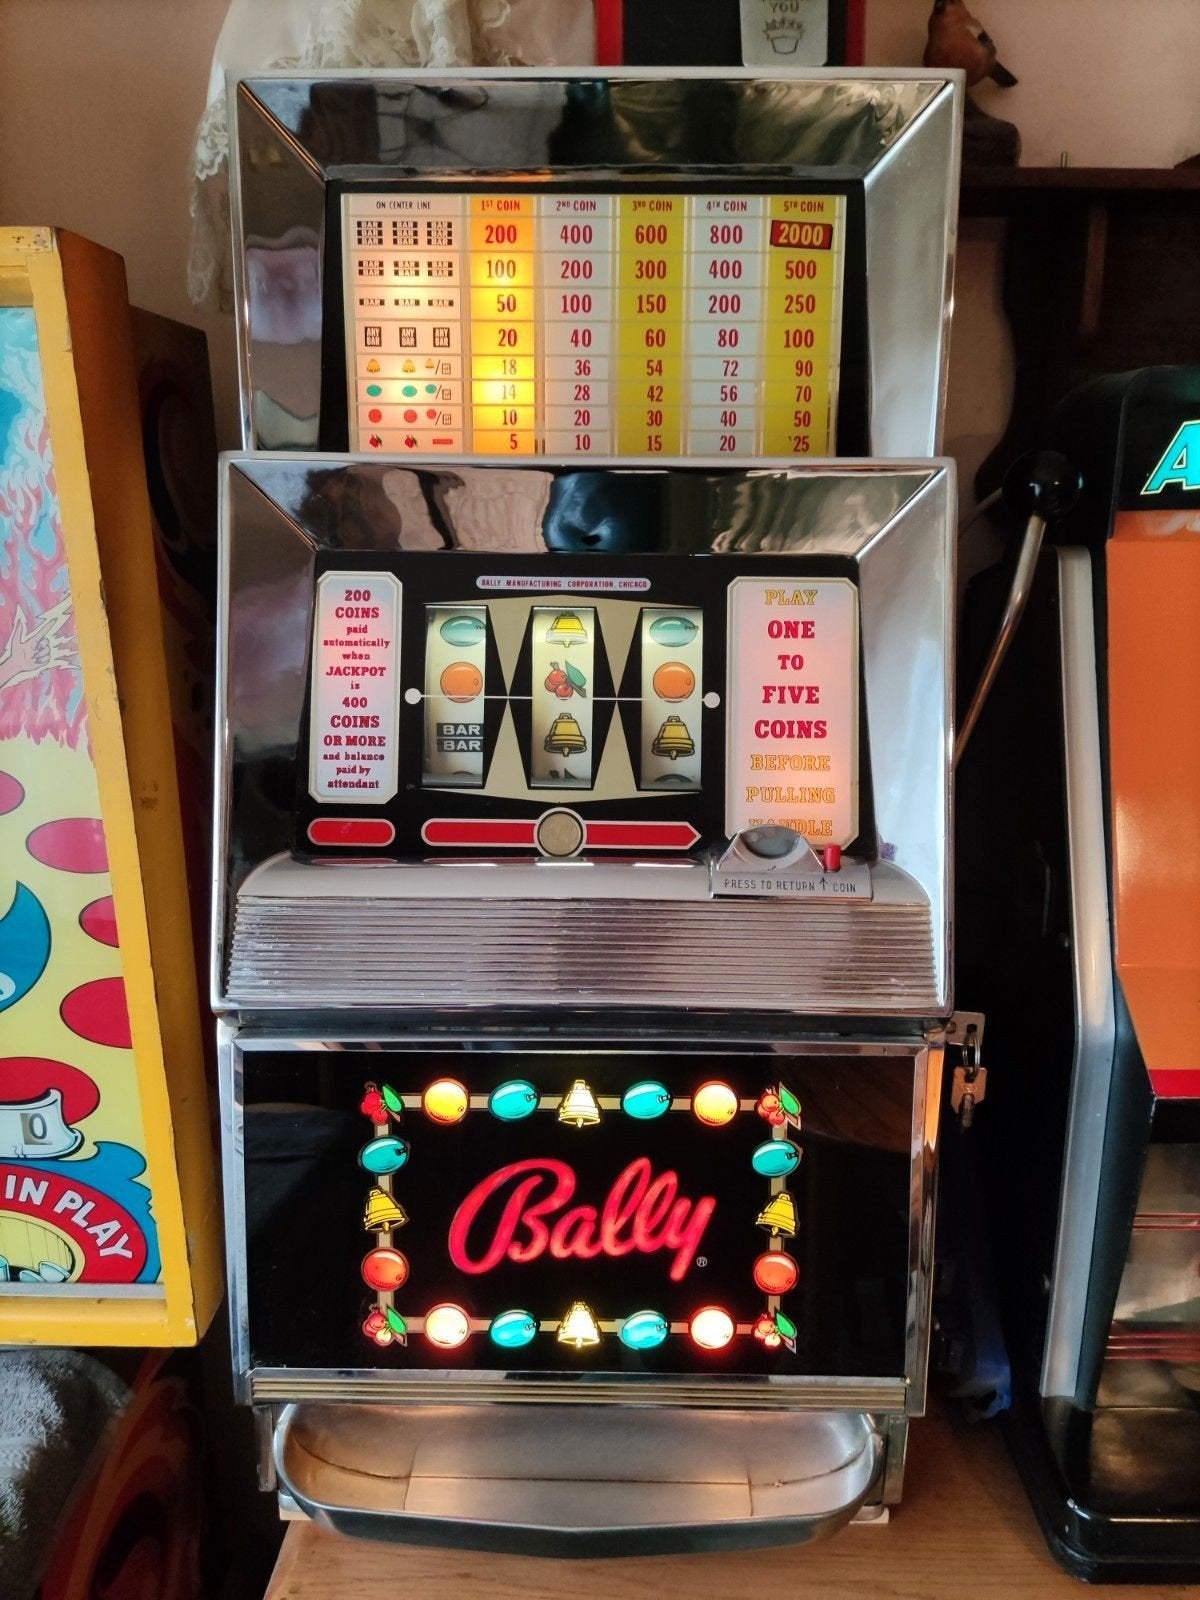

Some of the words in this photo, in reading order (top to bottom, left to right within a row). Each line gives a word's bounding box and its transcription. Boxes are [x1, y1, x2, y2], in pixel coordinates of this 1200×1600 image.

[771, 2, 800, 13] YOU
[376, 201, 386, 209] ON
[390, 201, 412, 209] CENTER
[417, 201, 431, 209] LINE
[496, 200, 520, 211] COIN
[574, 201, 597, 211] COIN
[650, 201, 672, 211] COIN
[723, 201, 747, 212] COIN
[800, 201, 824, 212] COIN
[485, 225, 517, 244] 200
[560, 225, 592, 244] 400
[635, 225, 667, 244] 600
[710, 225, 743, 244] 800
[778, 223, 823, 245] 2000
[486, 260, 516, 278] 100
[561, 260, 592, 279] 200
[635, 260, 667, 279] 300
[709, 260, 742, 279] 400
[785, 260, 817, 279] 500
[496, 294, 517, 313] 50
[562, 294, 592, 313] 100
[636, 294, 666, 313] 150
[708, 294, 741, 313] 200
[784, 294, 816, 313] 250
[367, 327, 379, 337] ANY
[401, 328, 415, 337] ANY
[435, 328, 448, 337] ANY
[498, 329, 518, 347] 20
[570, 329, 592, 347] 40
[645, 329, 666, 348] 60
[718, 329, 739, 348] 80
[783, 329, 815, 348] 100
[502, 359, 517, 375] 18
[574, 359, 591, 376] 36
[646, 360, 663, 376] 54
[723, 360, 739, 377] 72
[795, 360, 813, 377] 90
[502, 385, 517, 400] 14
[574, 385, 590, 401] 28
[646, 385, 663, 401] 42
[720, 386, 737, 402] 56
[795, 386, 812, 402] 70
[502, 409, 517, 425] 10
[574, 410, 590, 426] 20
[646, 410, 663, 427] 30
[720, 411, 737, 427] 40
[793, 411, 811, 428] 50
[510, 433, 518, 449] 5
[575, 434, 590, 450] 10
[647, 435, 662, 451] 15
[720, 435, 736, 452] 20
[793, 436, 810, 452] 25
[506, 579, 562, 587] MANUFACTURING
[345, 590, 371, 601] 200
[765, 589, 818, 605] PLAY
[335, 607, 379, 619] COINS
[346, 625, 368, 635] paid
[767, 620, 815, 639] ONE
[323, 639, 390, 649] automatically
[342, 652, 370, 660] when
[778, 655, 804, 671] TO
[326, 667, 386, 677] JACKPOT
[351, 682, 360, 690] is
[342, 697, 368, 708] 400
[762, 686, 820, 705] FIVE
[330, 715, 380, 728] COINS
[754, 720, 827, 739] COINS
[443, 724, 481, 736] BAR
[323, 735, 342, 747] OR
[345, 735, 386, 747] MORE
[443, 740, 481, 751] BAR
[323, 752, 340, 761] and
[345, 752, 385, 761] balance
[751, 755, 830, 771] BEFORE
[336, 765, 357, 776] paid
[359, 765, 370, 776] by
[327, 780, 379, 789] attendant
[746, 787, 835, 803] PULLING
[725, 879, 756, 889] PRESS
[761, 880, 772, 890] TO
[776, 881, 815, 891] RETURN
[833, 883, 856, 892] COIN
[28, 1112, 48, 1140] 0
[5, 1174, 49, 1206] IN
[53, 1190, 133, 1259] PLAY
[448, 1156, 716, 1282] Bally
